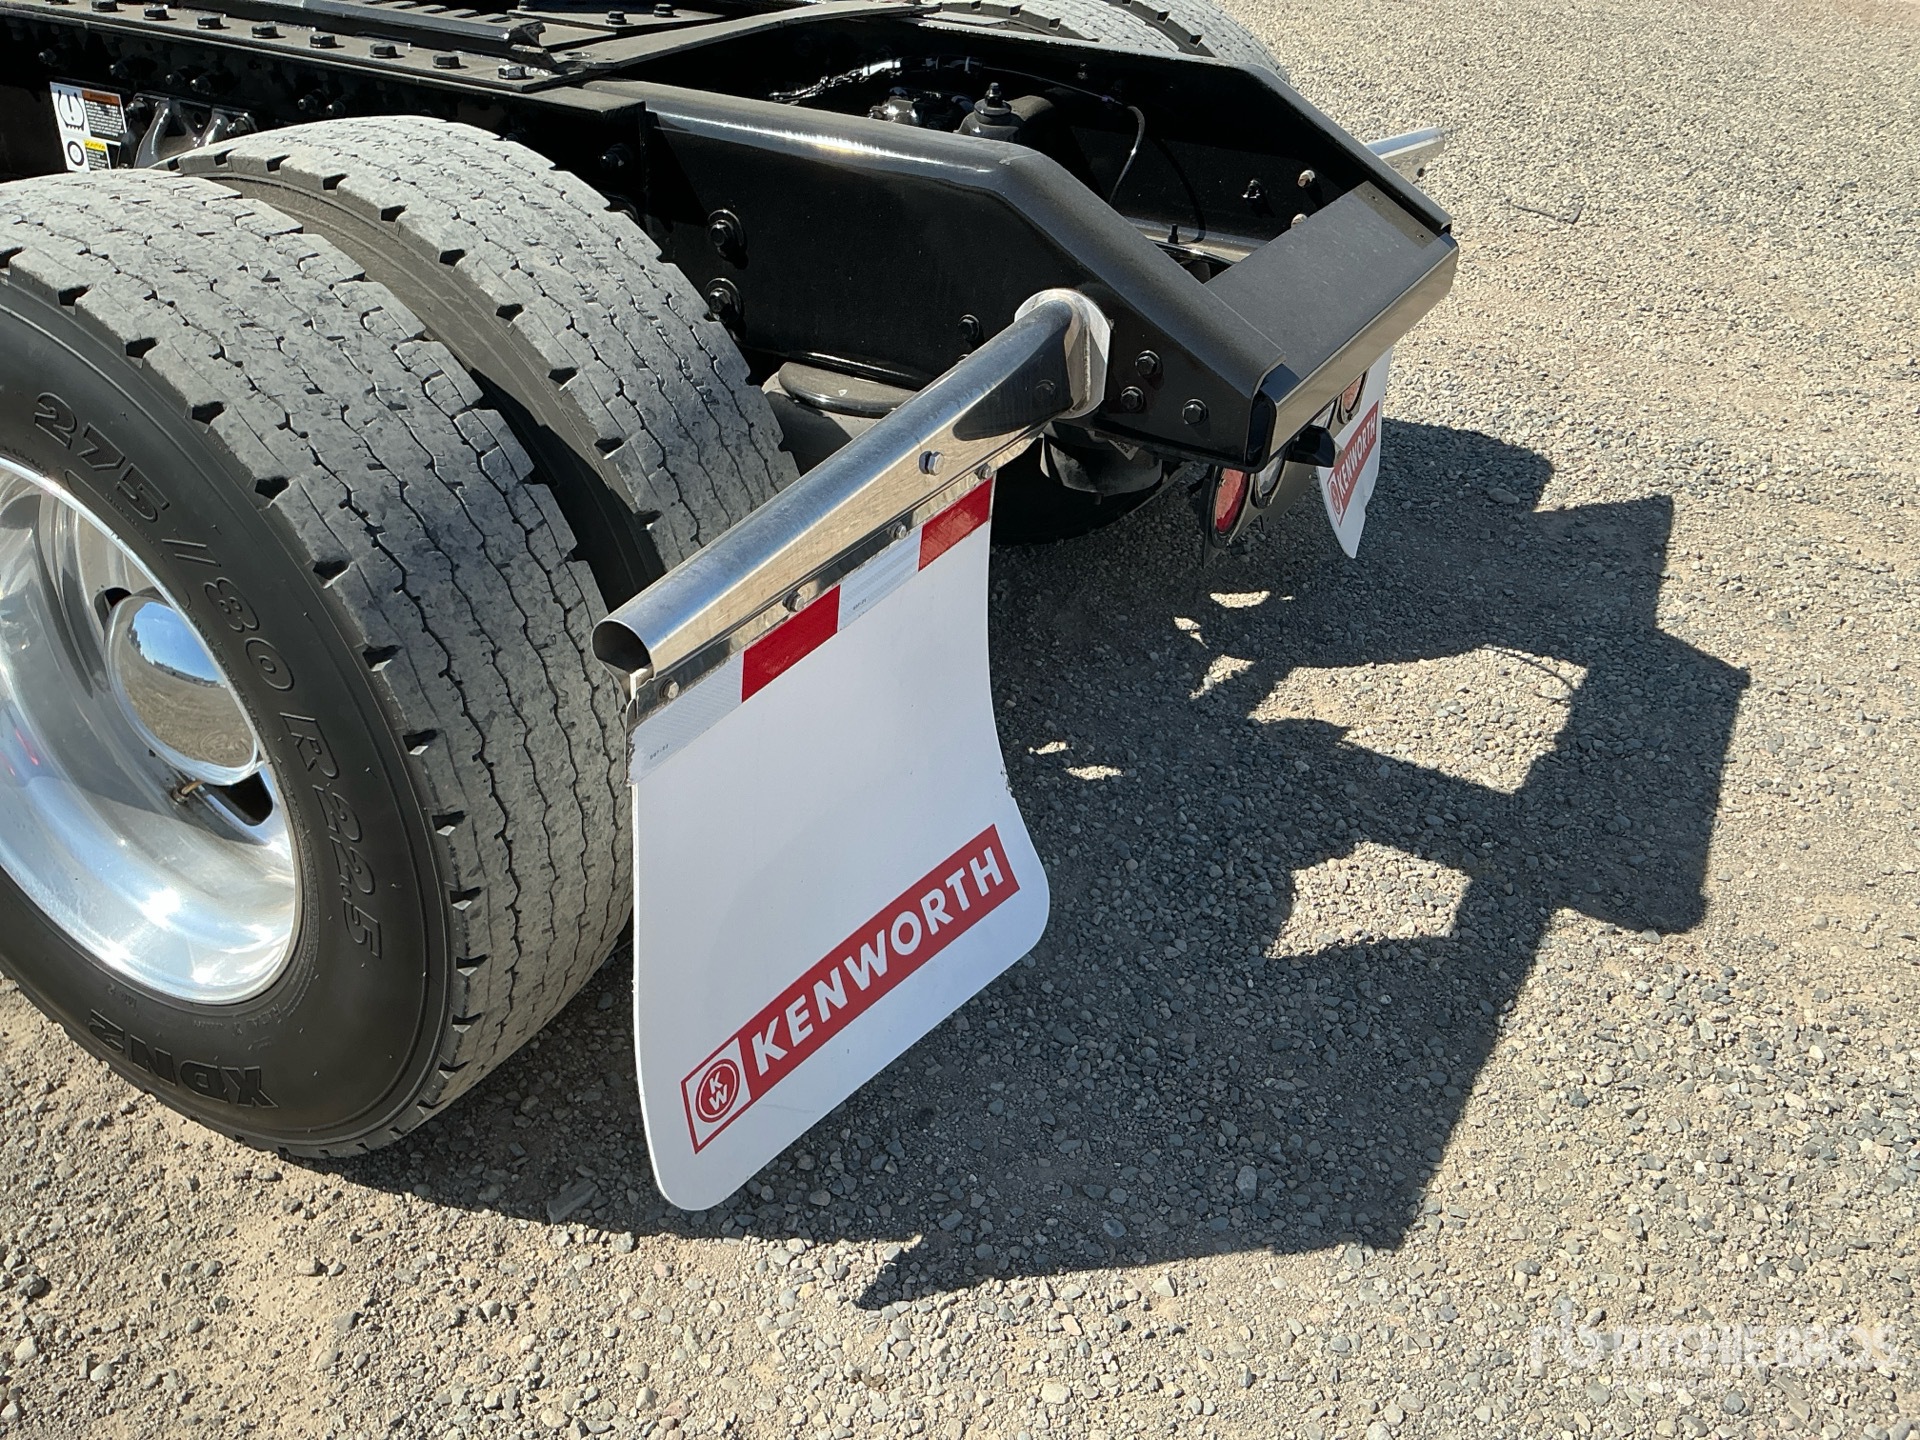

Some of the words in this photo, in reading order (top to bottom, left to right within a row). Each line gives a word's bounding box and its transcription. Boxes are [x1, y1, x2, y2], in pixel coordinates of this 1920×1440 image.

[1337, 412, 1377, 498] KENWORTH
[751, 846, 1005, 1076] KENWORTH
[88, 1008, 279, 1109] XDN2
